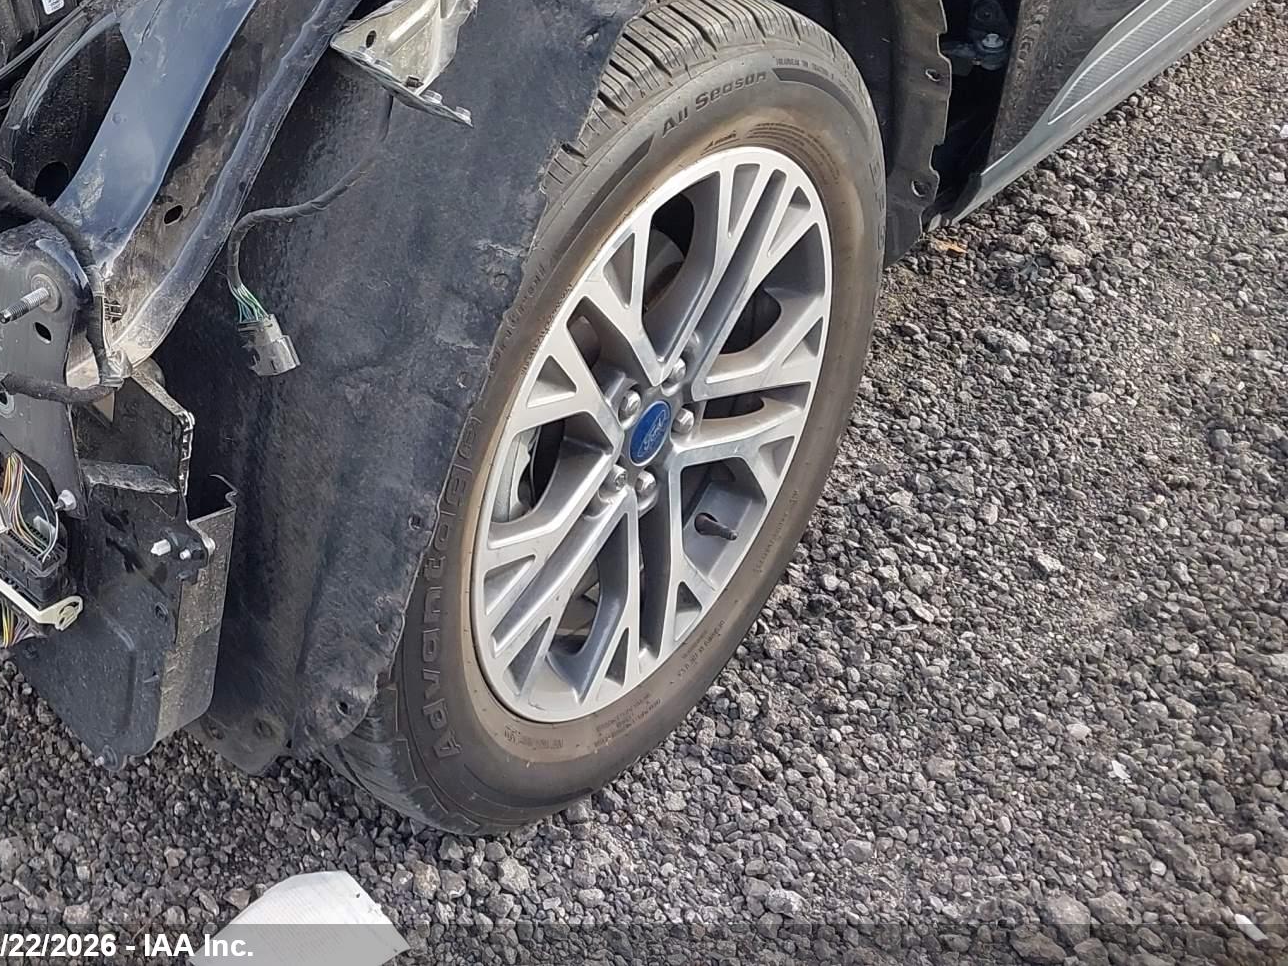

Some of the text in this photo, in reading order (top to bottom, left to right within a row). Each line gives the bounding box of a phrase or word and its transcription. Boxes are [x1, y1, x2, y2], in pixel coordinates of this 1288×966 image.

[662, 106, 689, 138] All
[695, 70, 767, 112] Season
[636, 409, 669, 458] Ford
